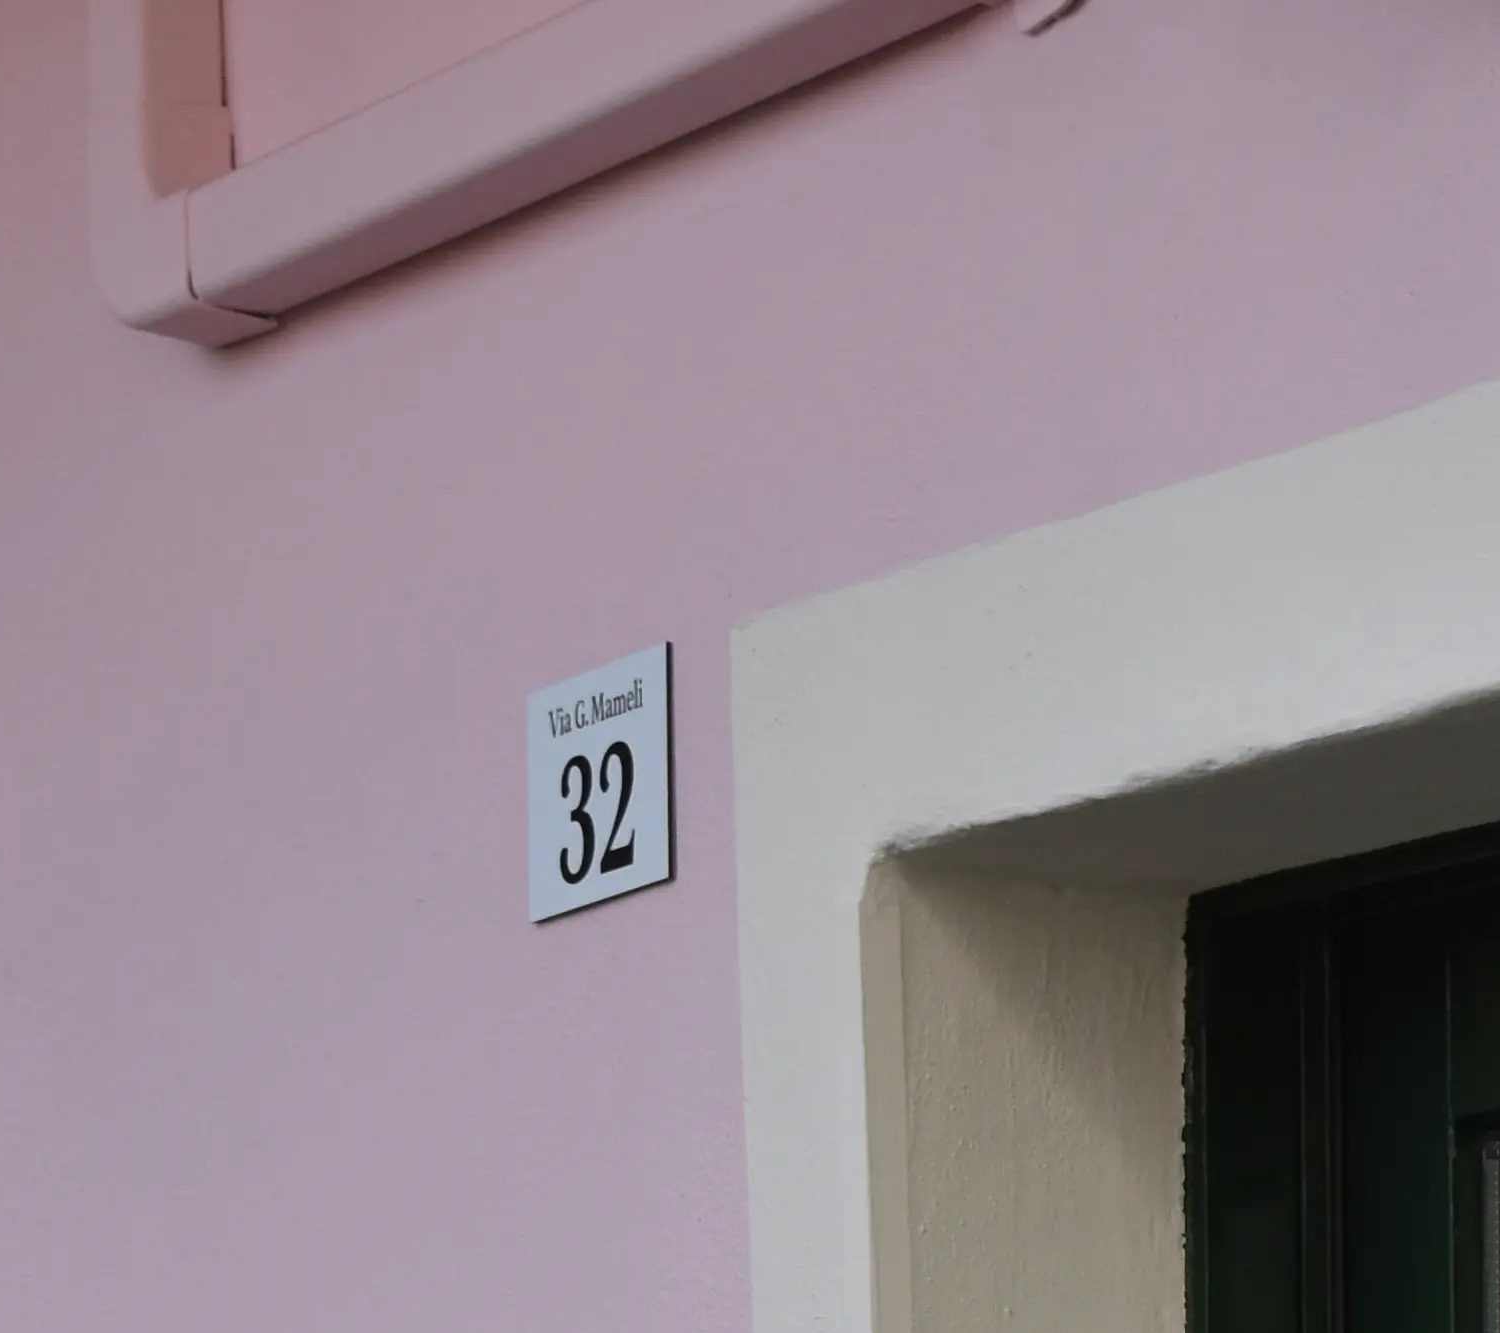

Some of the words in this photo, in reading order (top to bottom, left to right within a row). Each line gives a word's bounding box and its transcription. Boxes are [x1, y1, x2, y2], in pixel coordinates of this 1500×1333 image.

[548, 707, 572, 738] Via
[575, 699, 589, 729] G.
[591, 678, 643, 725] Mameli
[560, 741, 635, 884] 32
